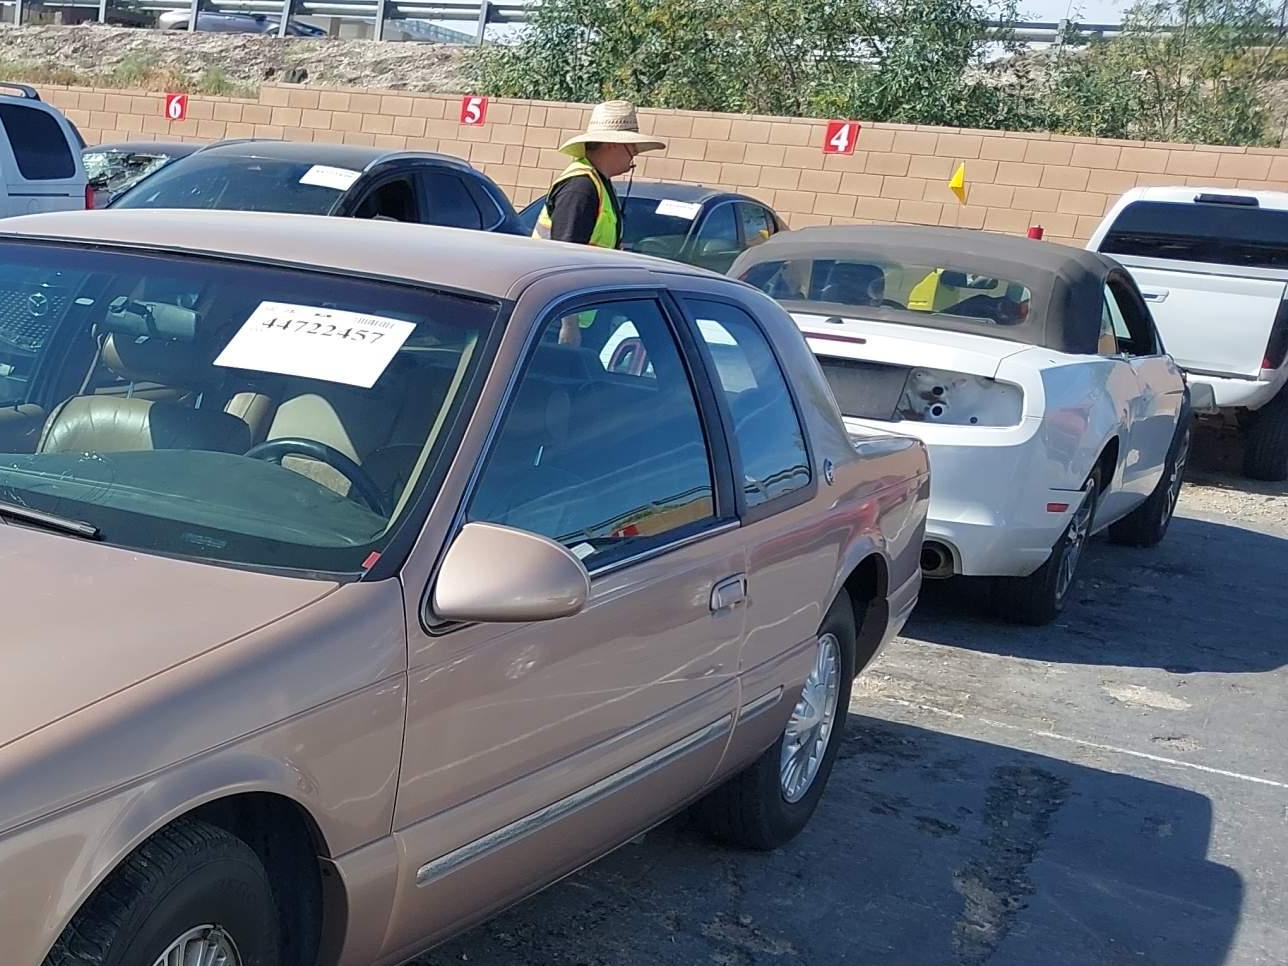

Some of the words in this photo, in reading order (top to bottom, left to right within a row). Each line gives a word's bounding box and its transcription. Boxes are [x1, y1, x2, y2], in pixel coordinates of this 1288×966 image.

[168, 95, 182, 119] 6
[464, 97, 482, 124] 5
[829, 123, 850, 152] 4
[262, 317, 385, 344] 44722457
